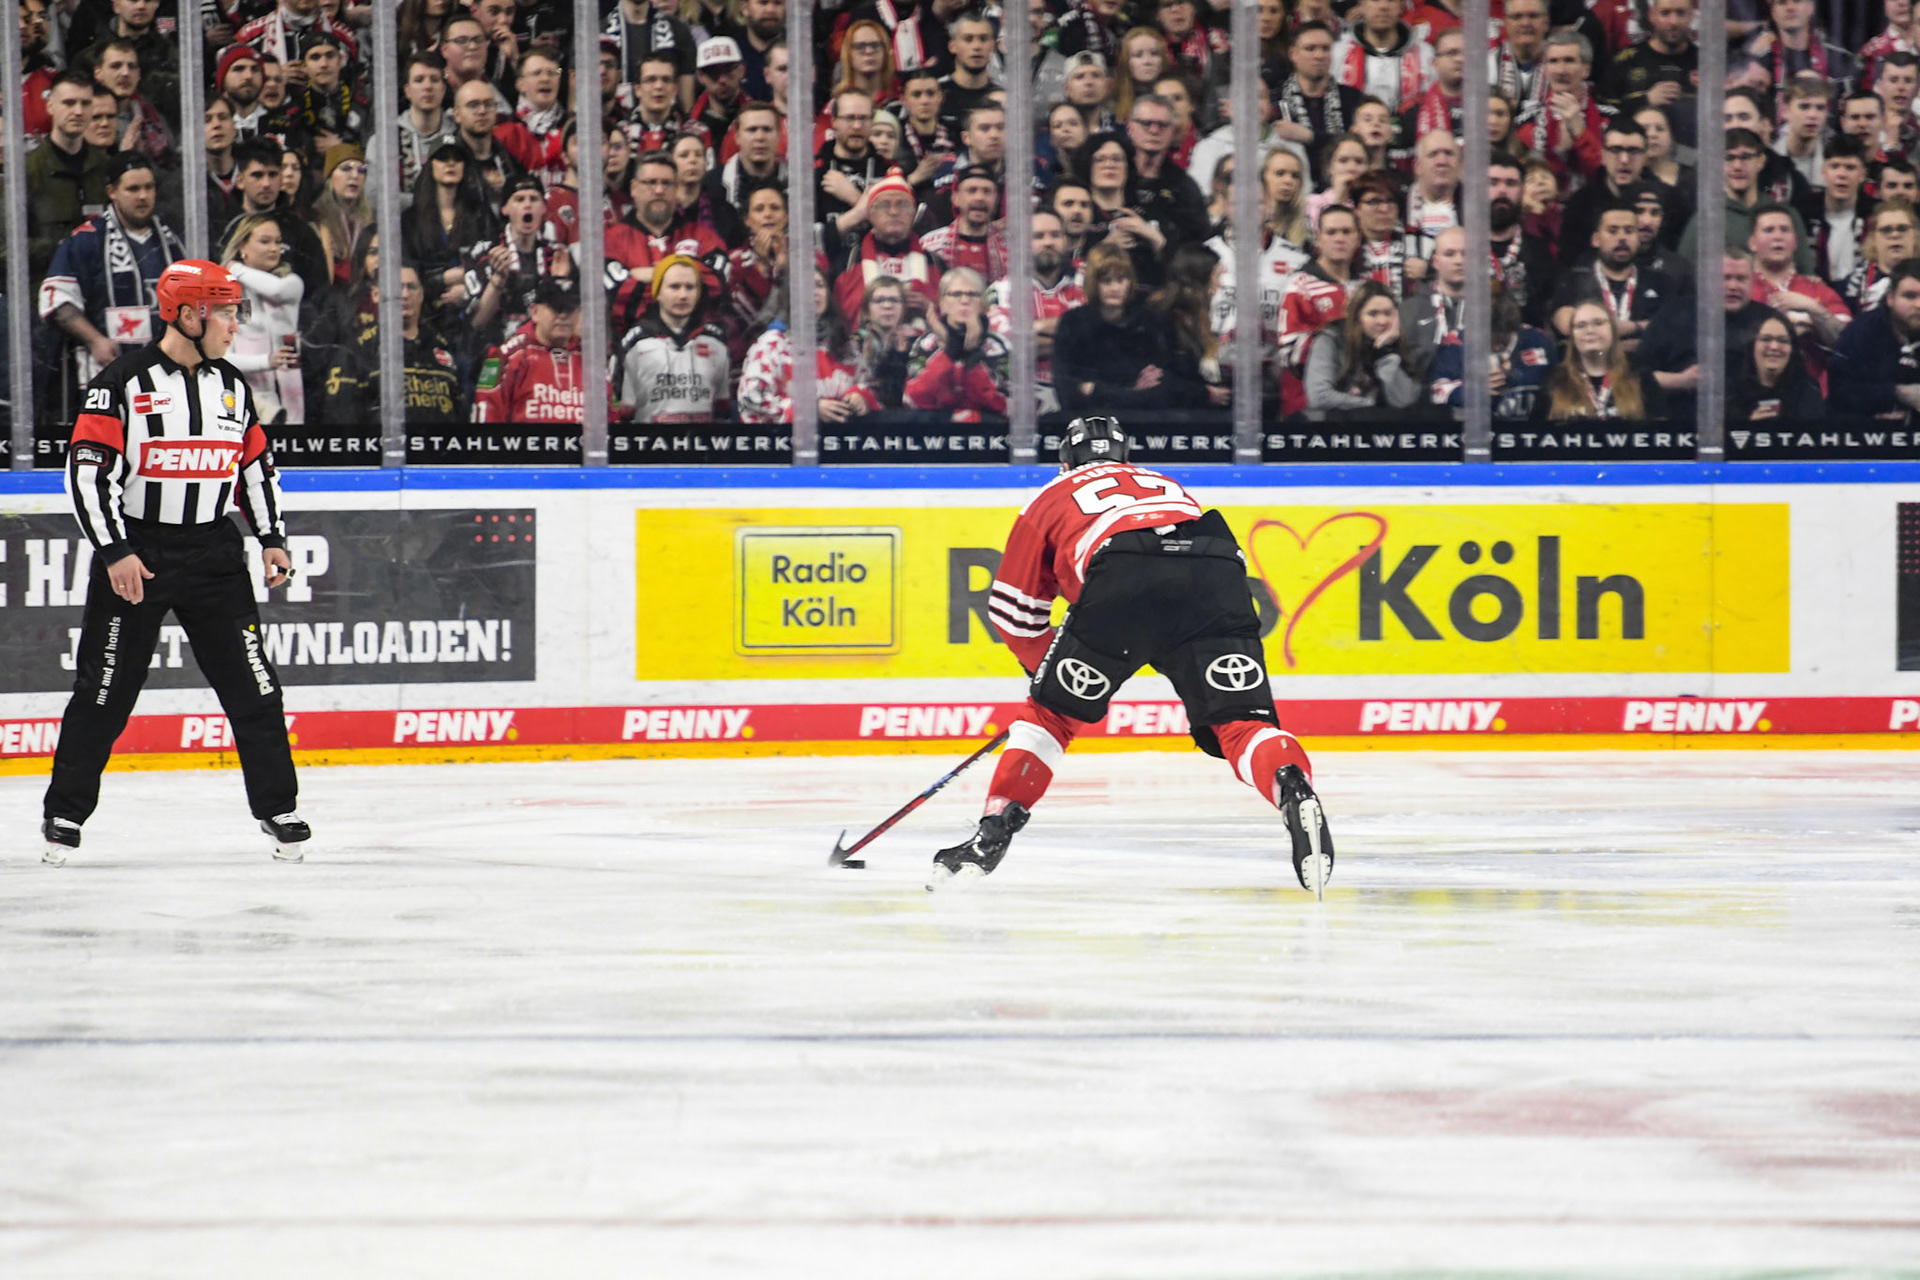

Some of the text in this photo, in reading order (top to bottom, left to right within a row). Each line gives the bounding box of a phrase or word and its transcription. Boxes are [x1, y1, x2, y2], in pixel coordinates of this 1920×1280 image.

[656, 372, 702, 387] Rhein
[84, 387, 111, 410] 20
[38, 437, 379, 454] STHLWERK
[410, 436, 579, 451] STAHLWERK
[614, 435, 790, 451] STAHLWERK
[823, 435, 1006, 451] STAHLWERK
[1043, 434, 1232, 450] SLWERK
[1266, 434, 1461, 449] STAHLWERK
[1499, 433, 1695, 448] STAHLWERK
[771, 552, 867, 584] Radio
[1358, 535, 1645, 642] Köln
[782, 595, 856, 628] Köln
[105, 616, 121, 650] hotels
[260, 619, 512, 666] WNLOADEN!
[104, 649, 116, 666] all
[102, 667, 114, 687] and
[1105, 703, 1191, 734] PEN
[0, 721, 62, 753] ENN
